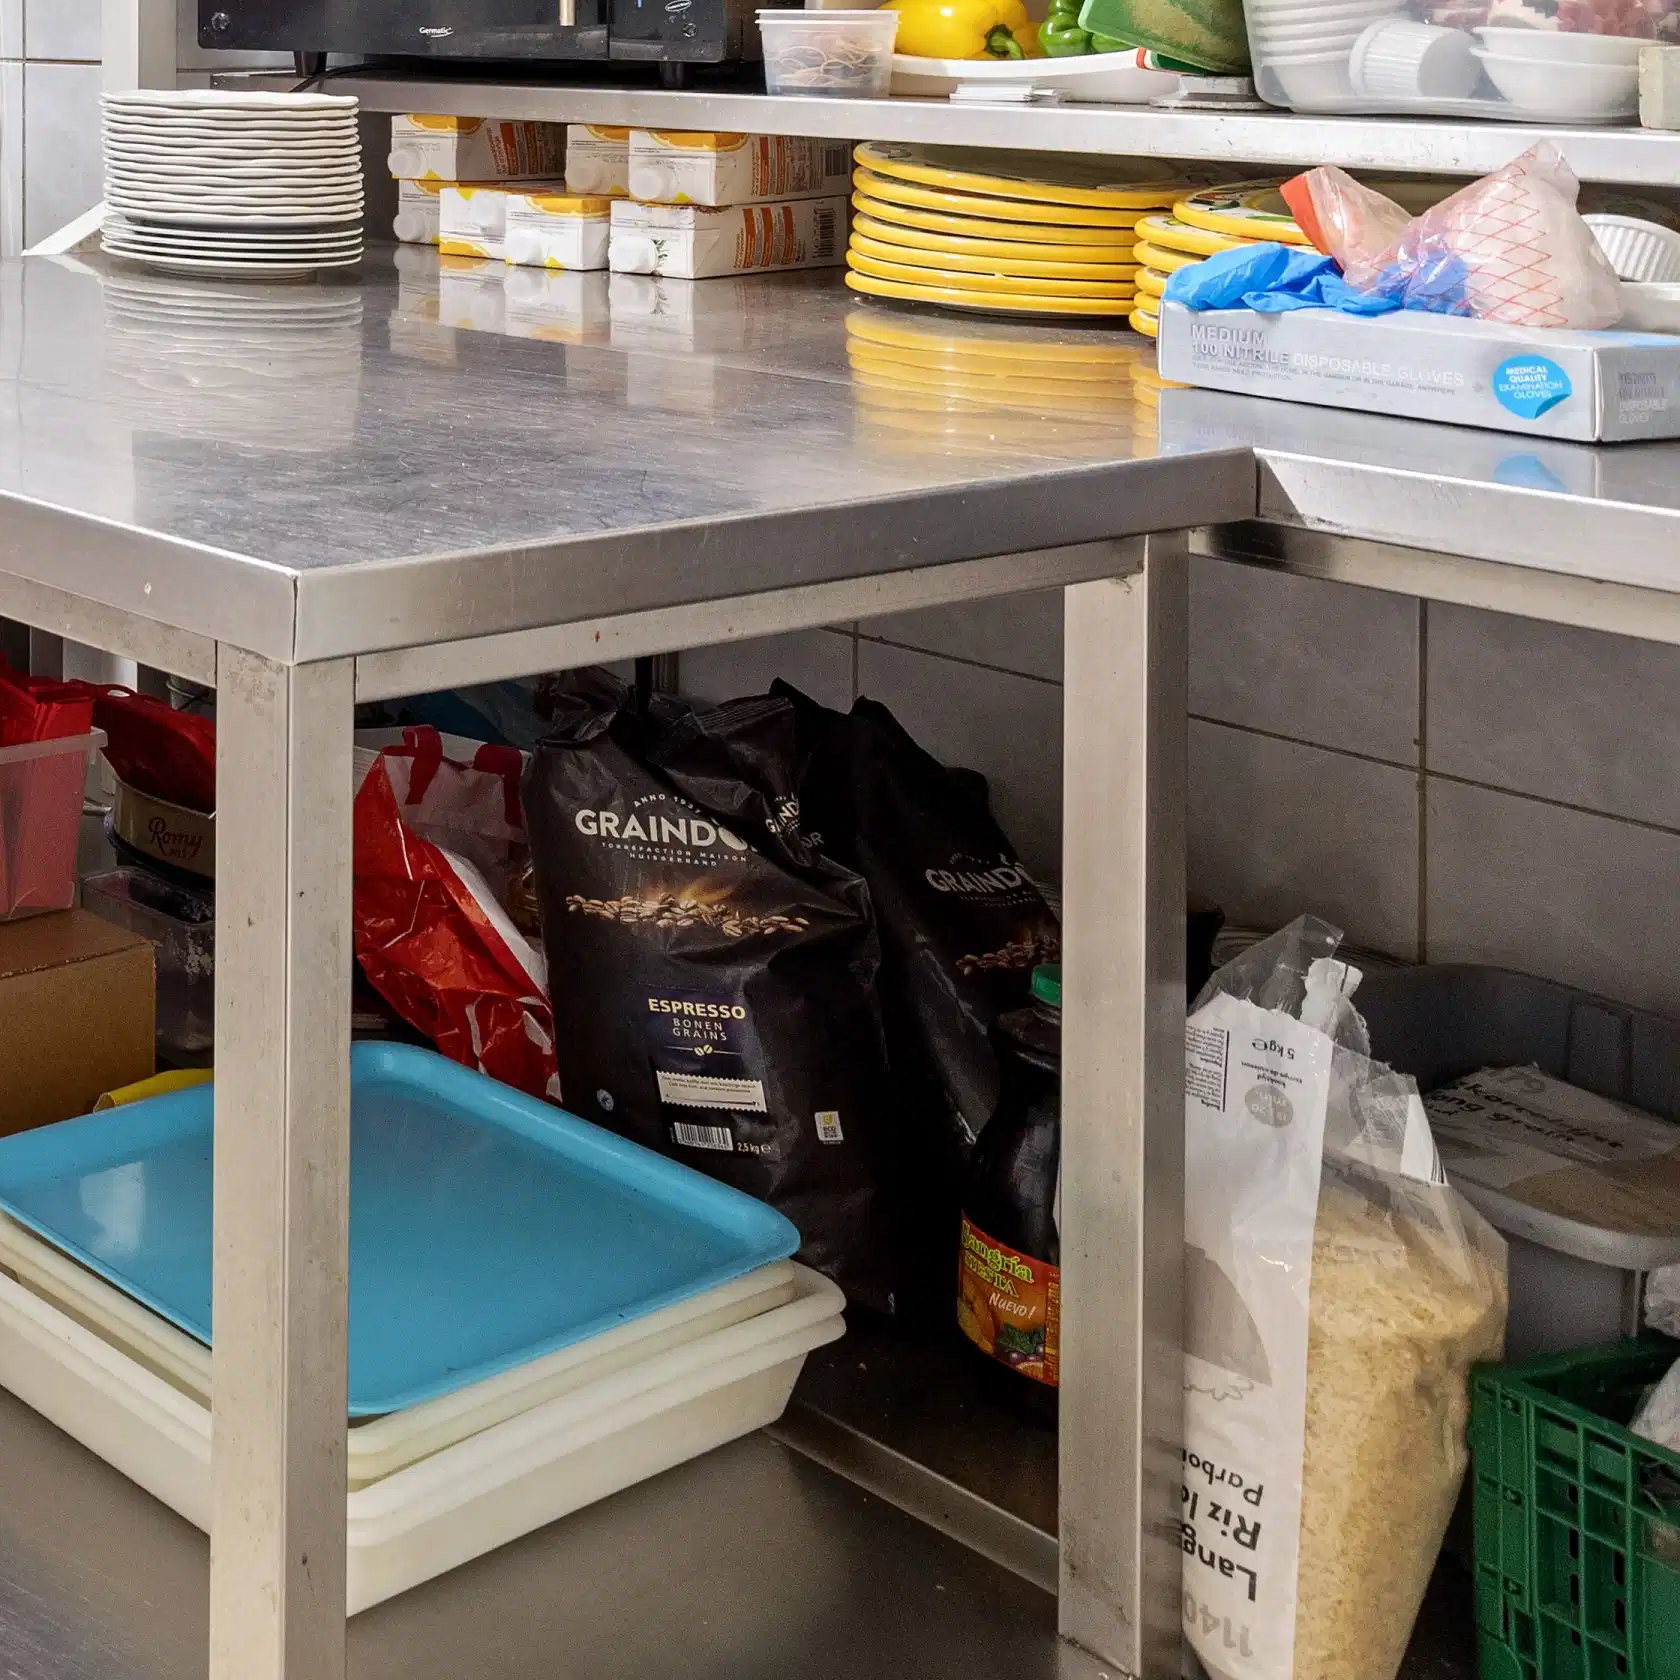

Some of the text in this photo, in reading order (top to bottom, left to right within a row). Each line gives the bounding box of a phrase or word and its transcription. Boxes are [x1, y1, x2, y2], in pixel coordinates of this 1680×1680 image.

[419, 26, 450, 35] Germatic
[1191, 324, 1266, 349] MEDIUM
[1191, 341, 1218, 357] 100
[1222, 343, 1290, 365] NITRILE
[1291, 352, 1390, 378] DISPOSABLE
[1397, 366, 1466, 387] GLOVES
[1505, 366, 1548, 375] MEDICAL
[1509, 374, 1547, 383] QUALITY
[1498, 381, 1563, 392] EXAMINATION
[1513, 389, 1552, 400] GLOVES
[633, 793, 666, 808] ANNO
[629, 852, 718, 867] HUISGEBRAND
[700, 851, 748, 863] MAISON
[648, 997, 747, 1020] ESPRESSO
[673, 1017, 723, 1032] BONEN
[672, 1027, 728, 1041] GRAINS
[1269, 1039, 1296, 1060] 5 kg
[737, 1142, 760, 1155] 2,5 kg
[1207, 1500, 1262, 1551] Riz
[1181, 1522, 1257, 1602] Lang
